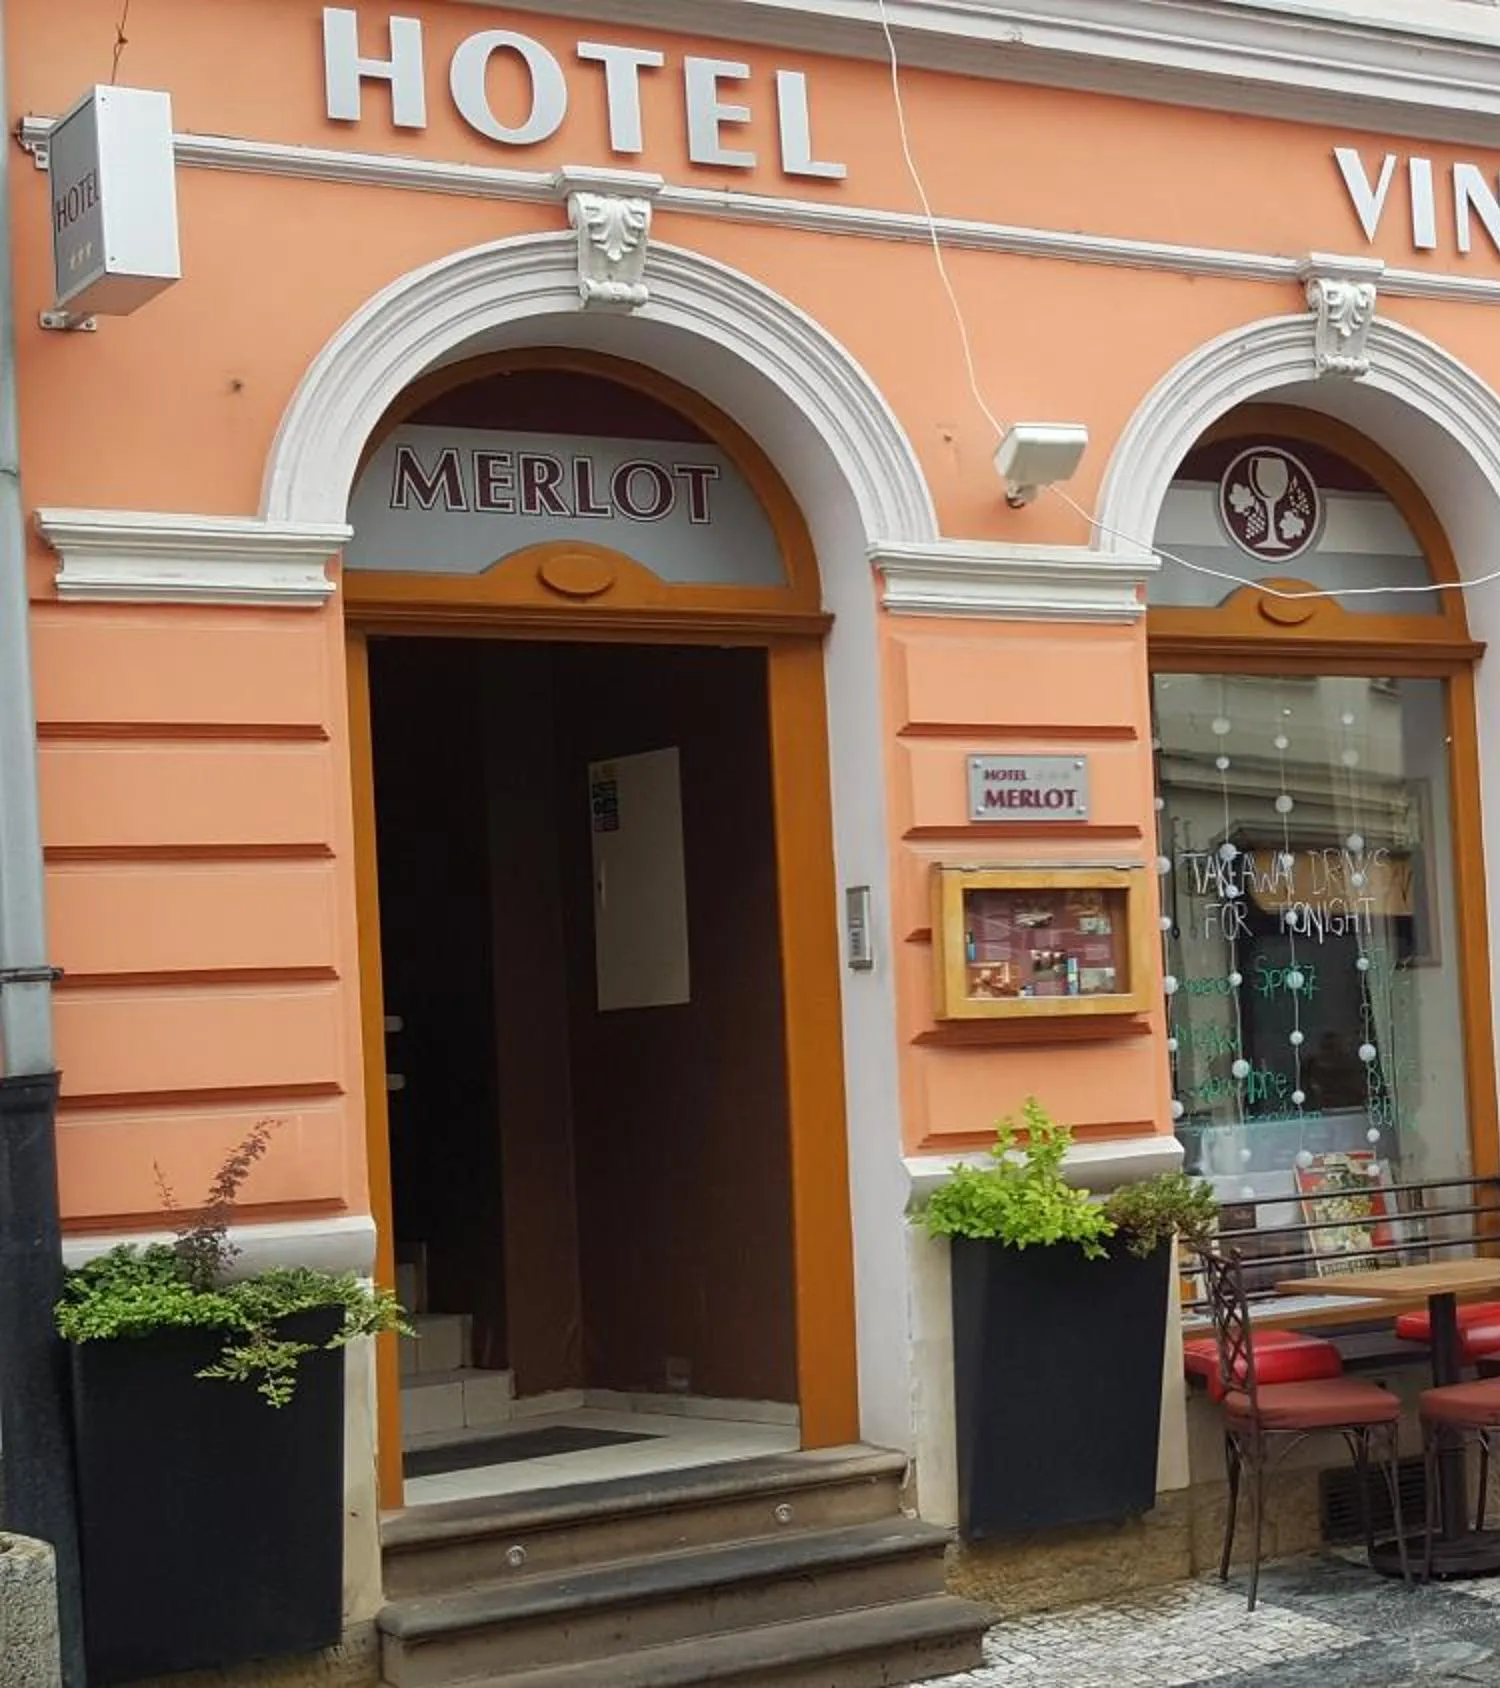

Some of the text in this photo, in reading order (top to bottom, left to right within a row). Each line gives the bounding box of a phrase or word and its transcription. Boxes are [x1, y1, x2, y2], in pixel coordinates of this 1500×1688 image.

[323, 7, 848, 180] HOTEL
[55, 167, 101, 233] HOTEL
[390, 445, 721, 526] MERLOT
[984, 769, 1028, 781] HOTEL
[984, 788, 1079, 809] MERLOT
